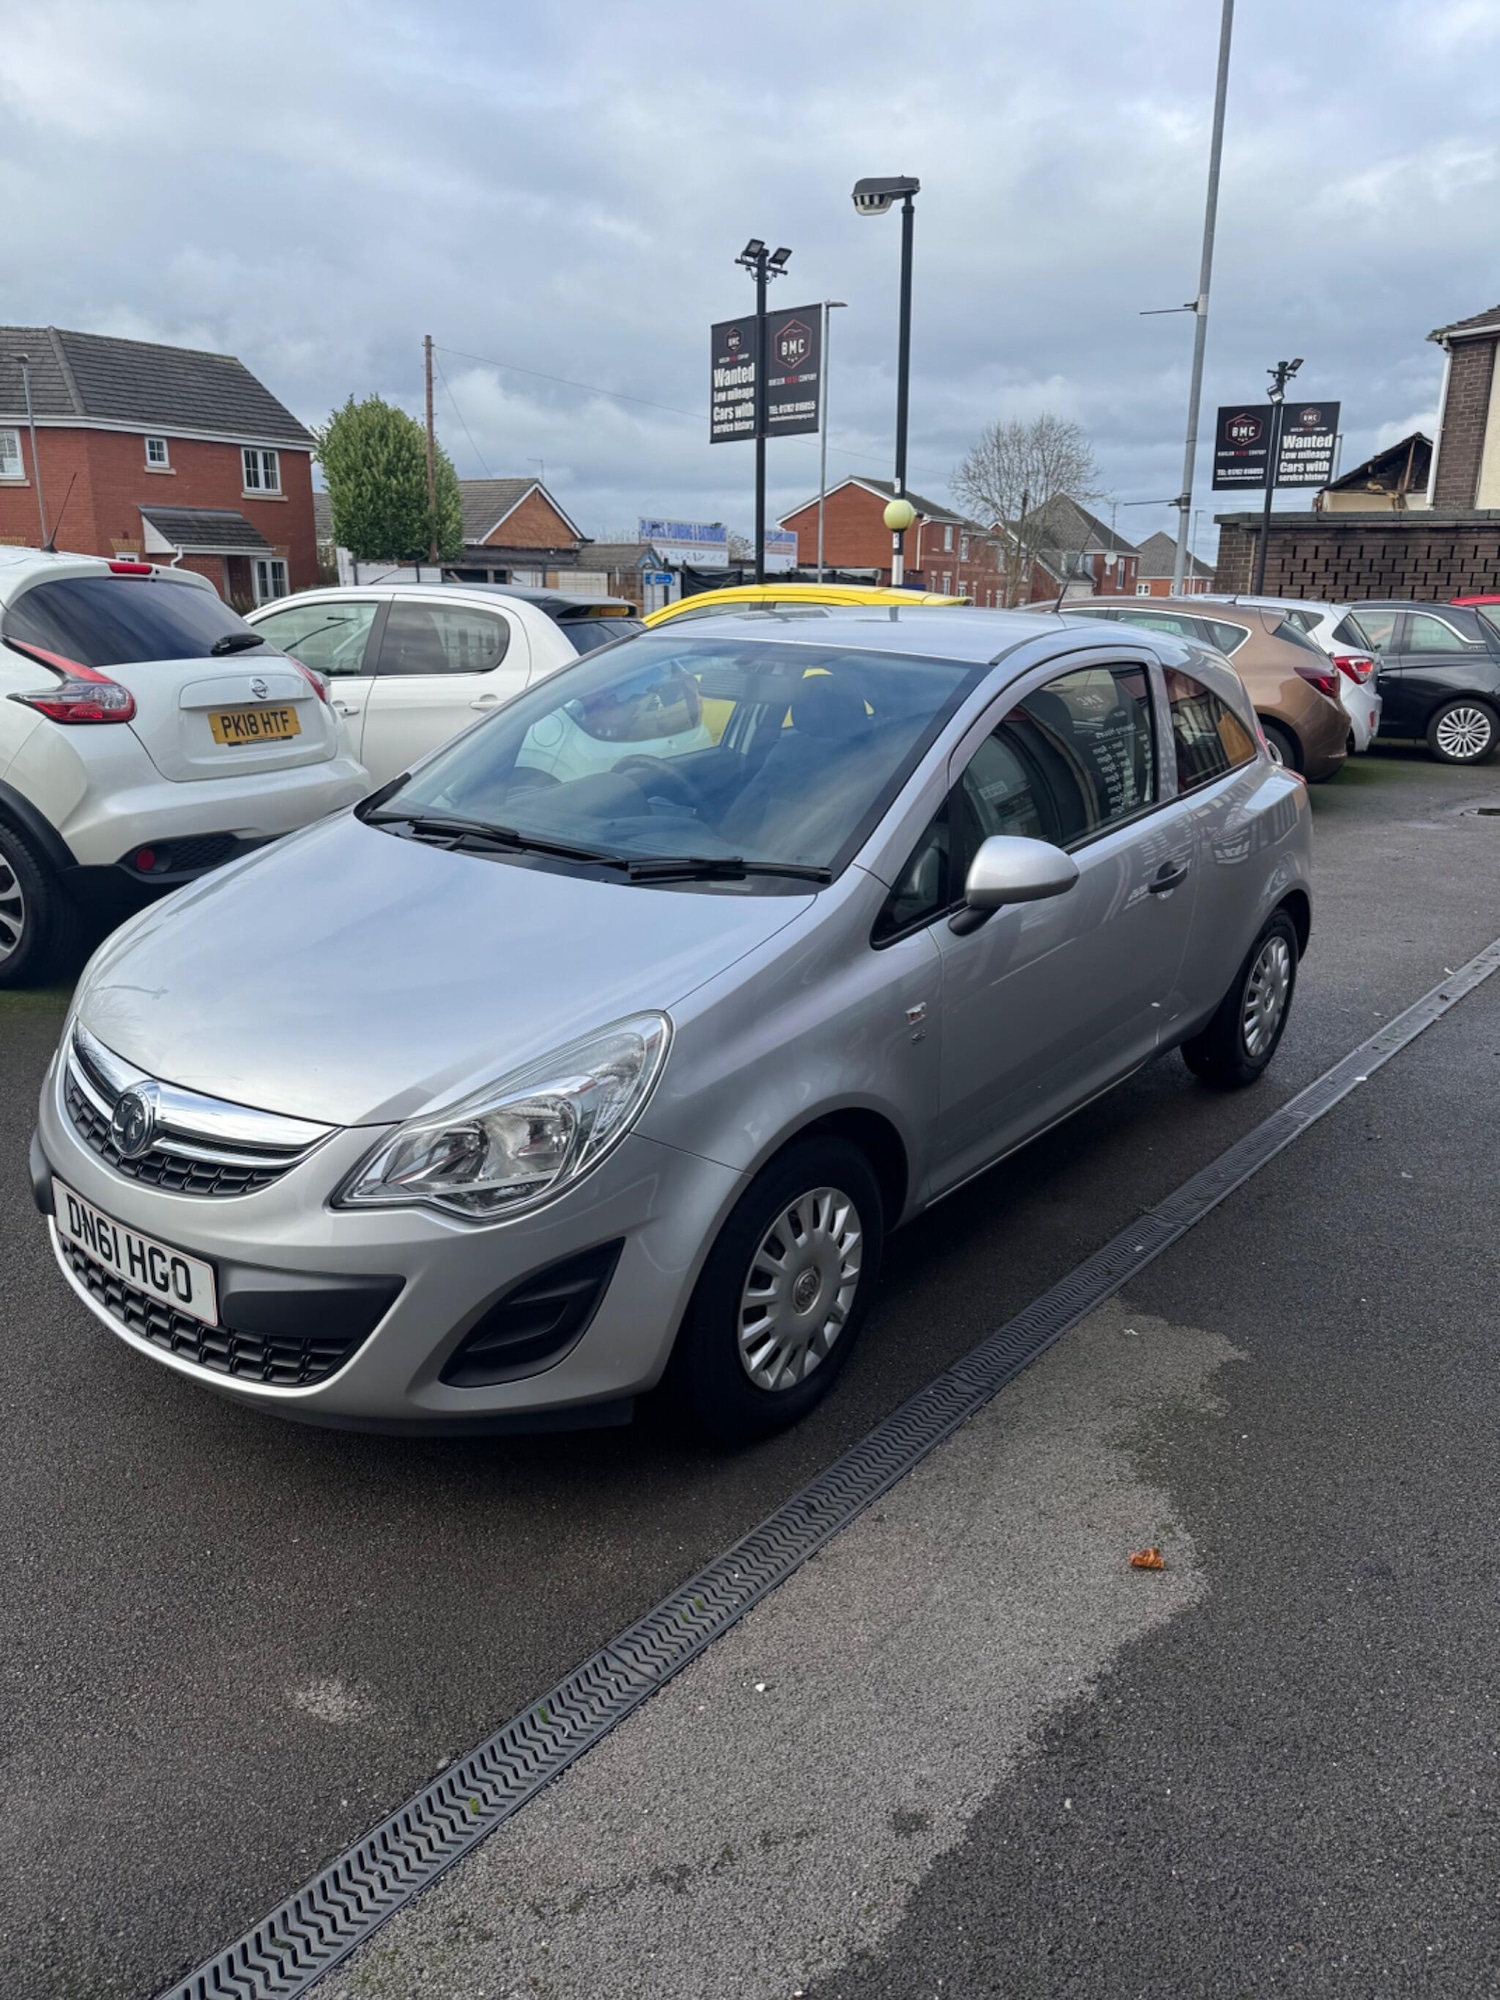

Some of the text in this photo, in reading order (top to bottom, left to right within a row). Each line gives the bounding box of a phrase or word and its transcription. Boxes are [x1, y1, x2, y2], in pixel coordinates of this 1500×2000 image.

[781, 339, 805, 356] BMC
[714, 362, 755, 388] Wanted
[714, 387, 754, 403] Low mileage
[713, 406, 734, 422] Cars
[735, 402, 755, 418] with
[713, 420, 755, 434] service history
[1232, 426, 1256, 438] BMC
[1283, 434, 1334, 449] Wanted
[1281, 449, 1331, 460] Low mileage
[1280, 461, 1330, 473] Cars with
[1278, 473, 1329, 482] service history
[220, 710, 289, 738] PK18 HTF
[66, 1193, 193, 1304] DN61 HGO
